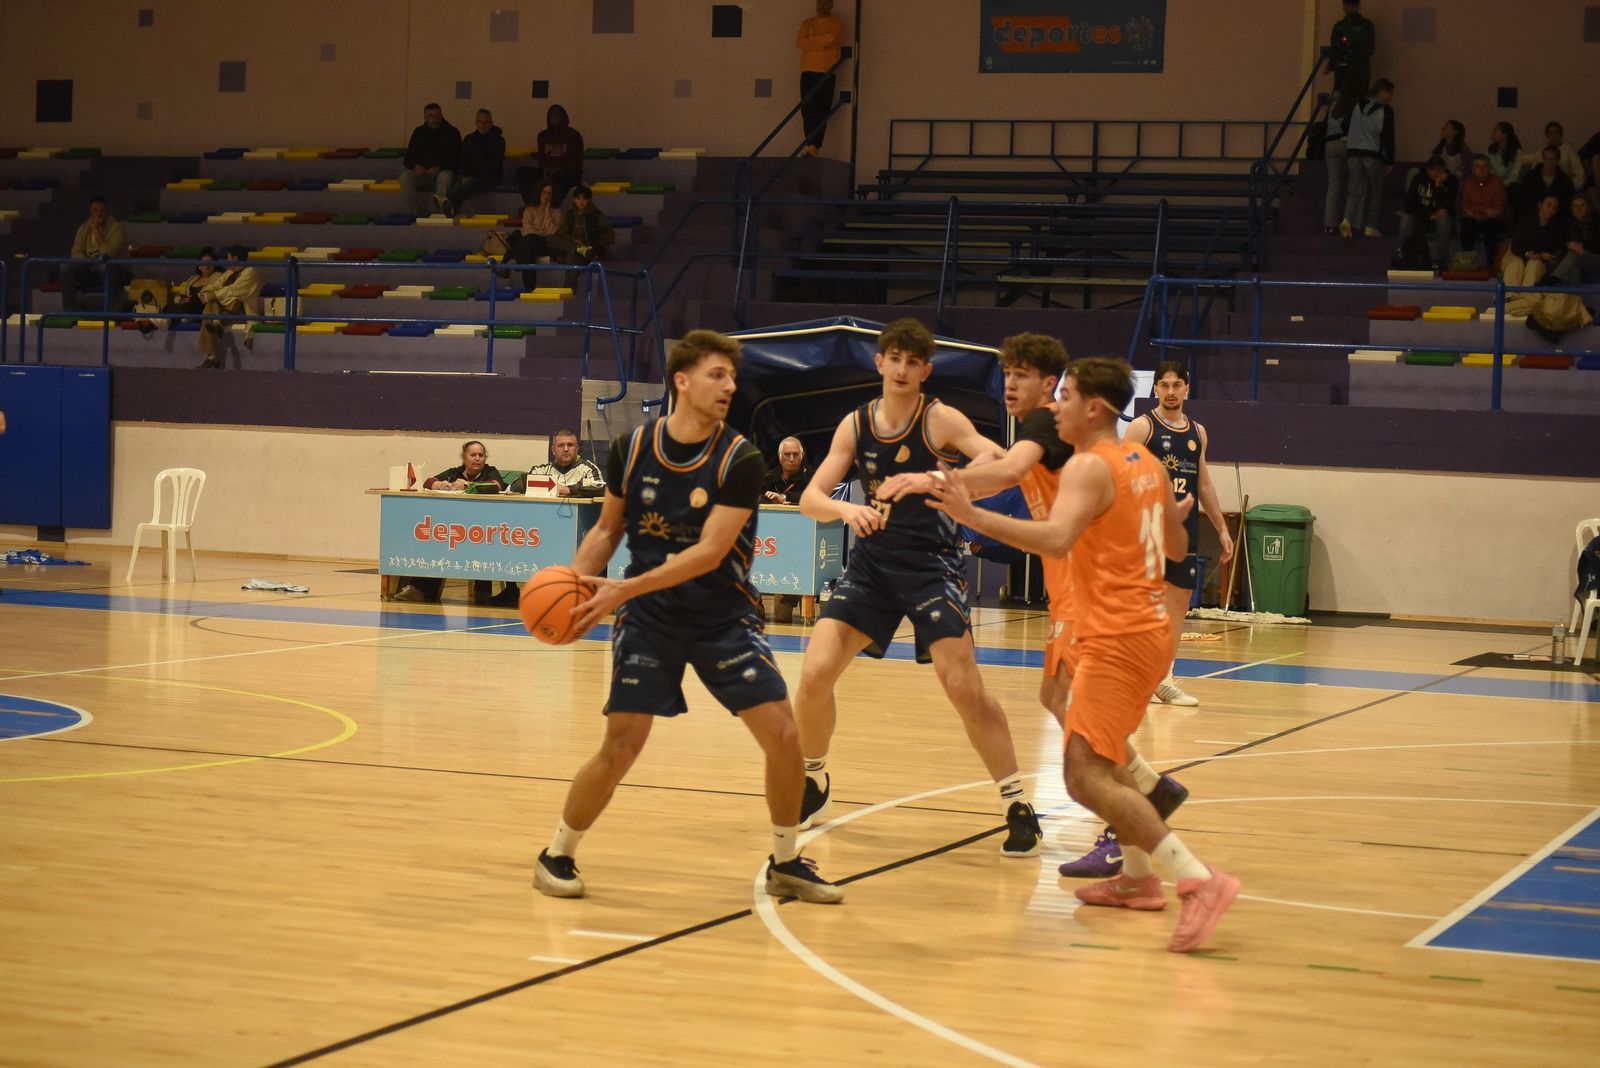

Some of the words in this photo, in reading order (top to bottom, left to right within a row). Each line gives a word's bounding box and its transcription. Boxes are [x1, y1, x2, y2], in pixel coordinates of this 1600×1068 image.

[993, 17, 1122, 50] deportes
[1173, 477, 1187, 494] 12
[414, 514, 541, 551] deportes
